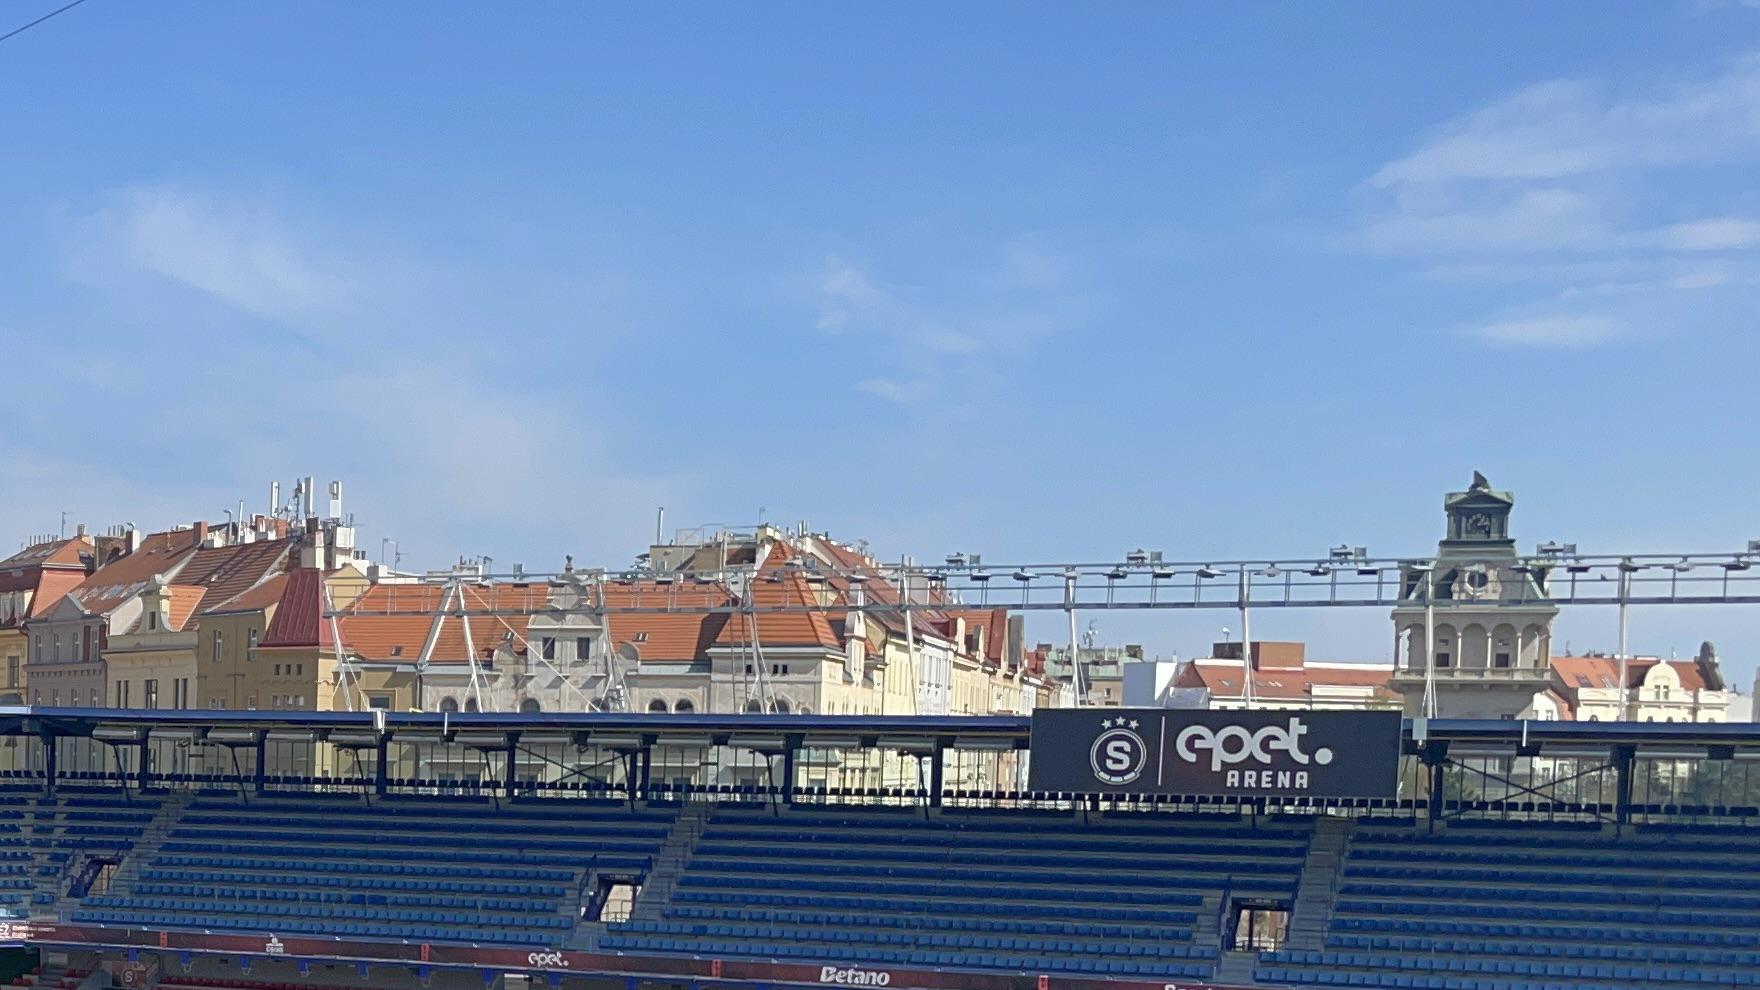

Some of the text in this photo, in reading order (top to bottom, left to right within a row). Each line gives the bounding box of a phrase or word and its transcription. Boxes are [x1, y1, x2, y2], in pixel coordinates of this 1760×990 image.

[1105, 741, 1131, 770] S
[1226, 770, 1309, 789] ARENA
[819, 966, 890, 986] Betano
